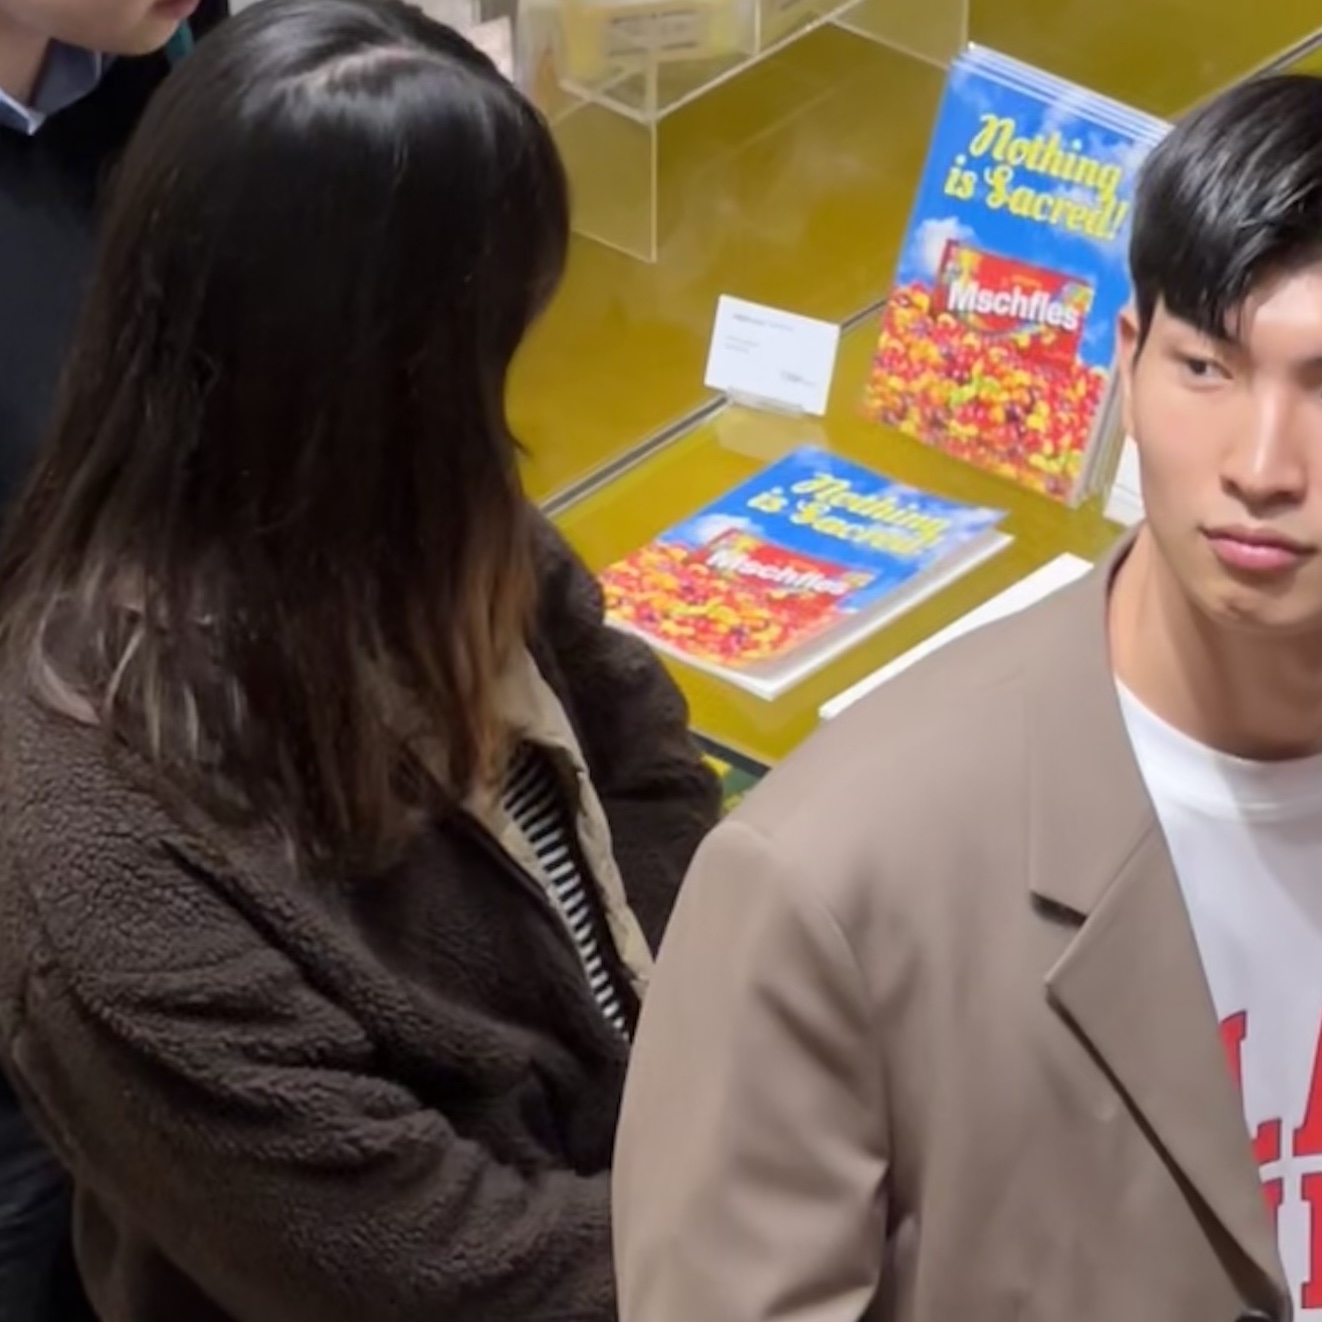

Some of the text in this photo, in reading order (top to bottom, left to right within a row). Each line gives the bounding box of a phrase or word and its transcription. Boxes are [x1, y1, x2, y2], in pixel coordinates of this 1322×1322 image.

[944, 154, 1129, 241] is Sacred!
[969, 114, 1121, 204] Nothing
[791, 472, 947, 543] Nothing
